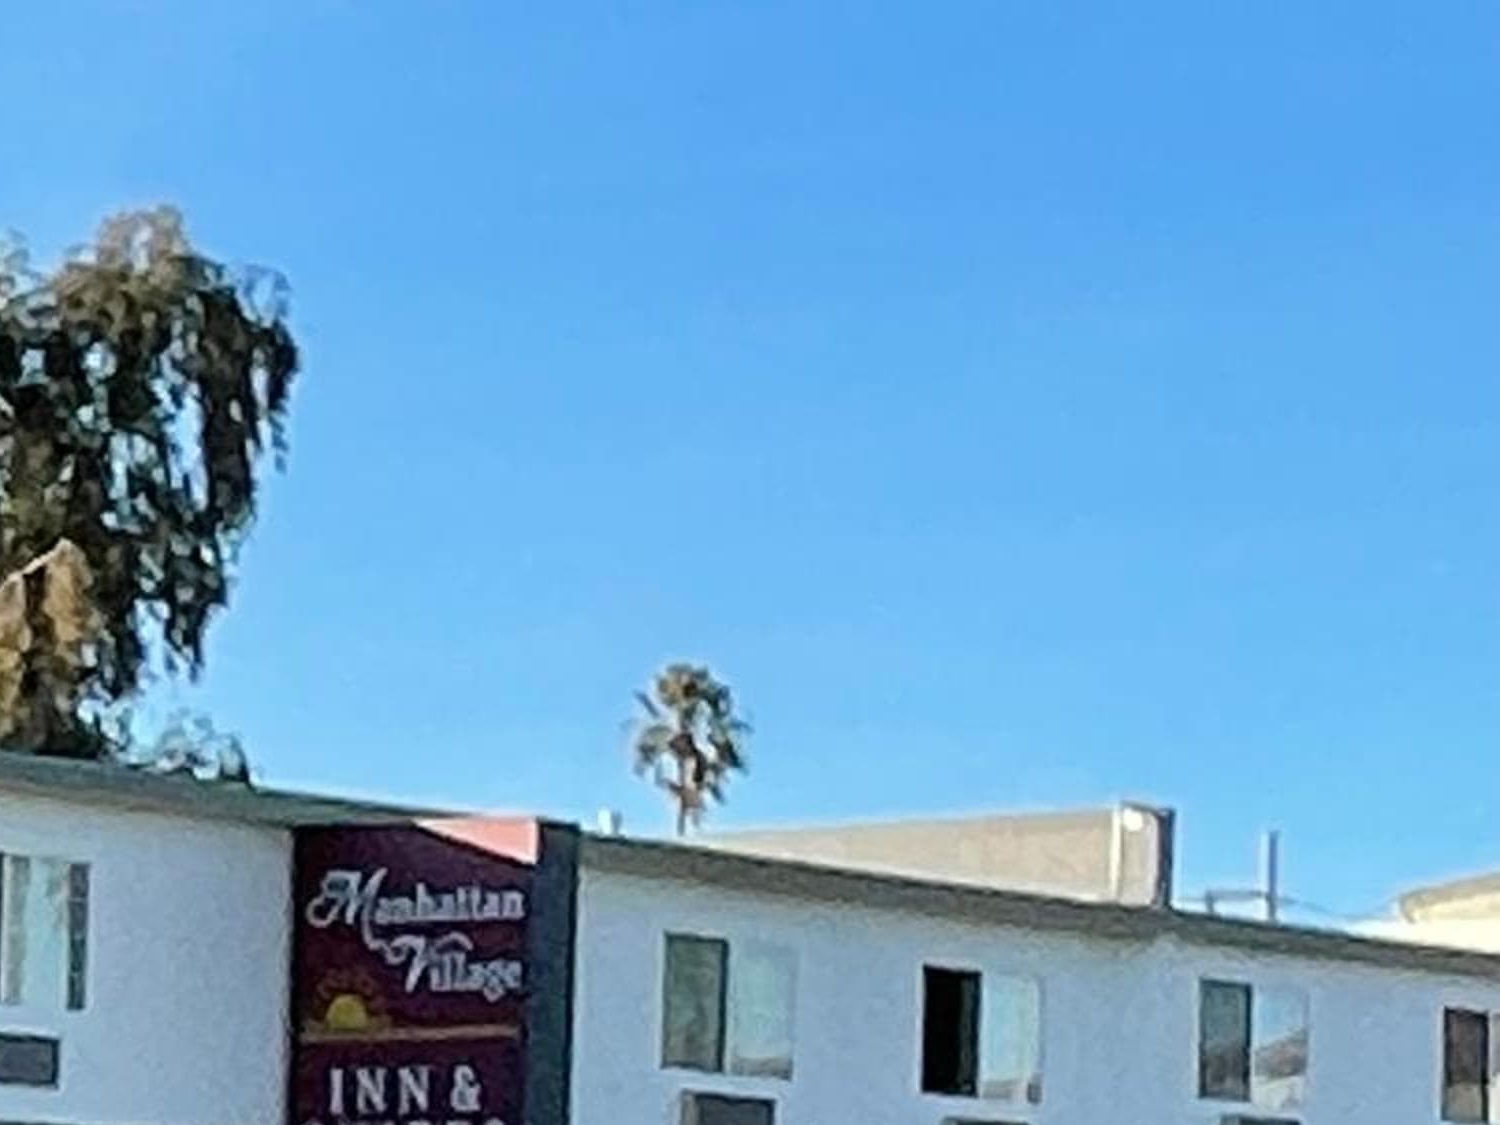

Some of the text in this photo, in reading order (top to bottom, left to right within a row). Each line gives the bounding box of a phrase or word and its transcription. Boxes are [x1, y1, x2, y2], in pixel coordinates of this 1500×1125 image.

[306, 867, 525, 949] Manhattan
[380, 932, 523, 1001] Village
[328, 1065, 483, 1115] INN &
